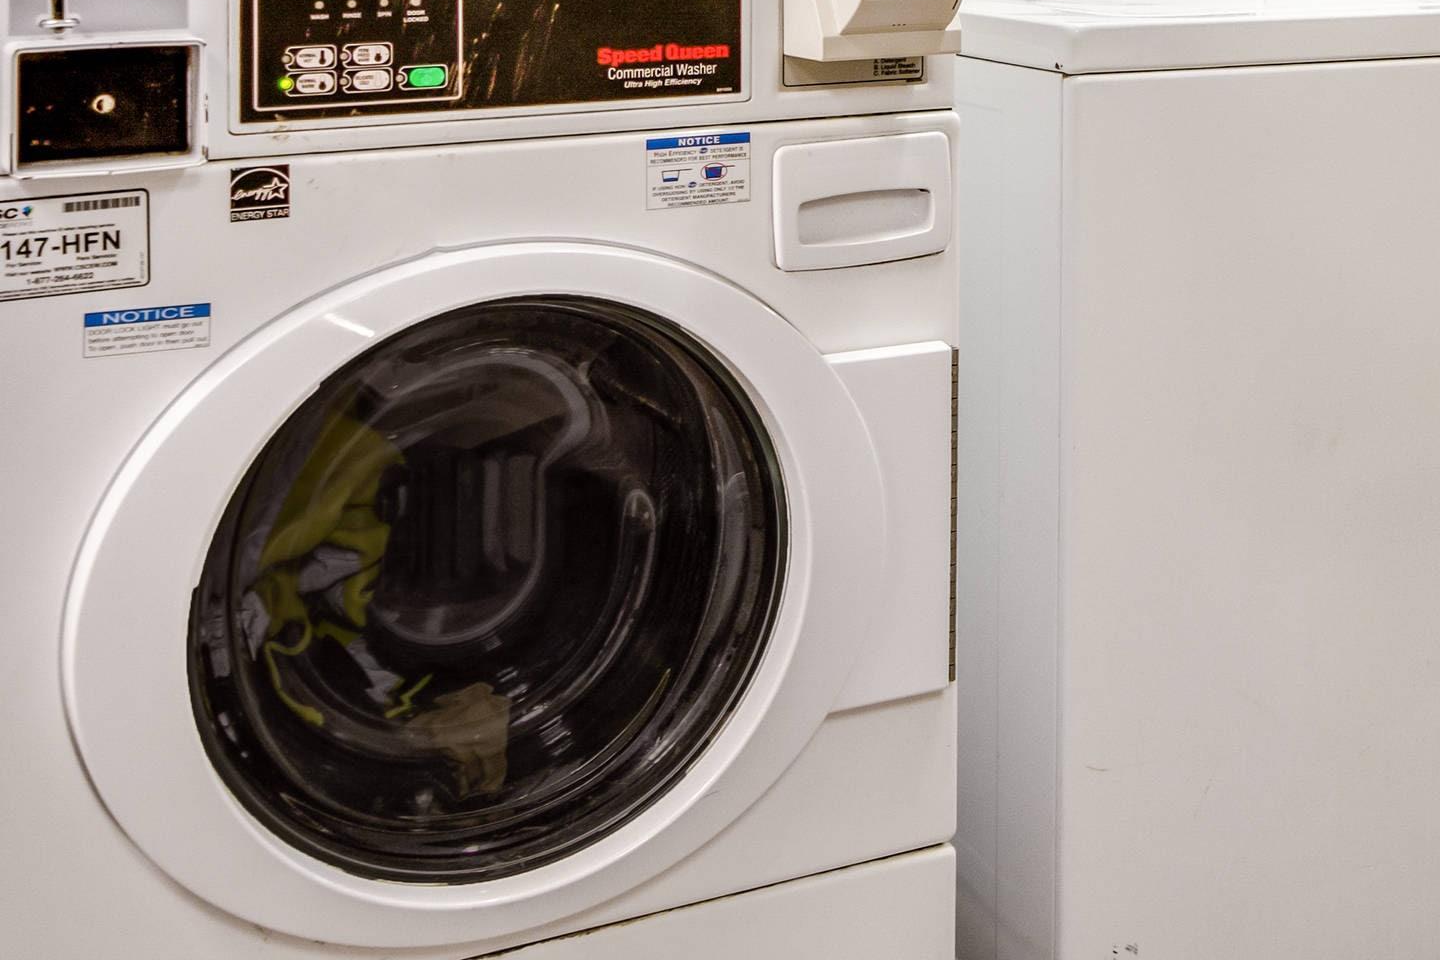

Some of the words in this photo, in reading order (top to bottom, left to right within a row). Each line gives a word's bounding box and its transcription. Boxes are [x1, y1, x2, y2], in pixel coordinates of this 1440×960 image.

[597, 44, 663, 67] Speed
[664, 43, 730, 60] Queen
[607, 64, 674, 80] Commercial
[676, 62, 718, 76] Washer
[644, 80, 663, 88] High
[664, 78, 703, 86] Efficiency
[678, 136, 720, 146] NOTICE
[231, 211, 266, 221] ENERGY
[266, 208, 289, 217] STAR
[0, 230, 121, 260] 147-HFN
[102, 306, 195, 324] NOTICE
